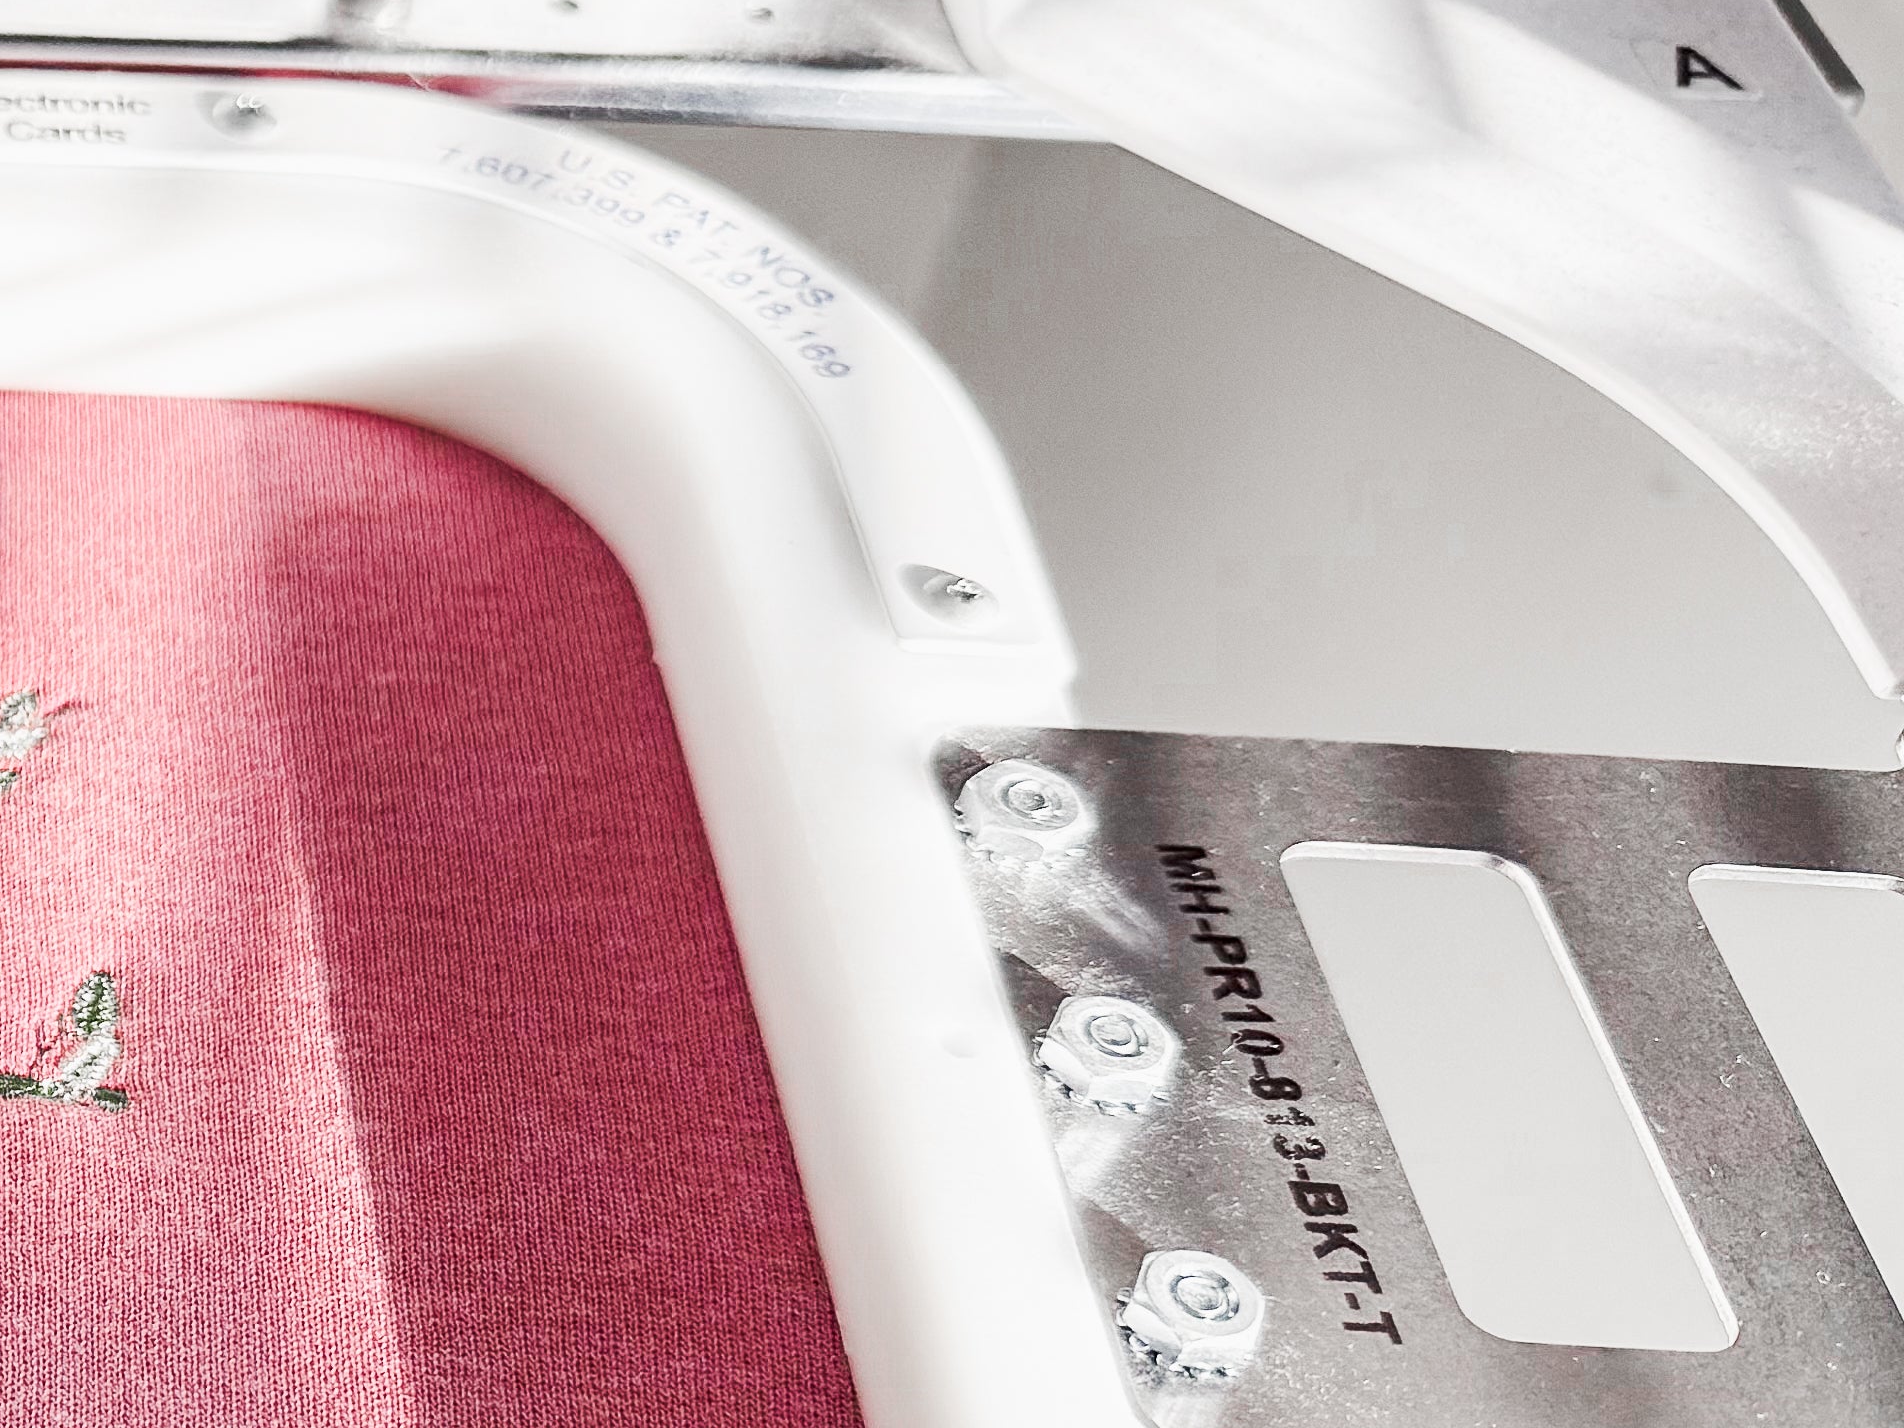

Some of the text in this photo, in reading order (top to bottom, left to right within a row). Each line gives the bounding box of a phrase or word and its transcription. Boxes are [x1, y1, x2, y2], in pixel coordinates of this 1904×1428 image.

[1676, 46, 1745, 92] A
[6, 119, 128, 145] Cards
[651, 228, 683, 249] &
[1154, 843, 1403, 1346] MH-PR10-813-BKT-T
